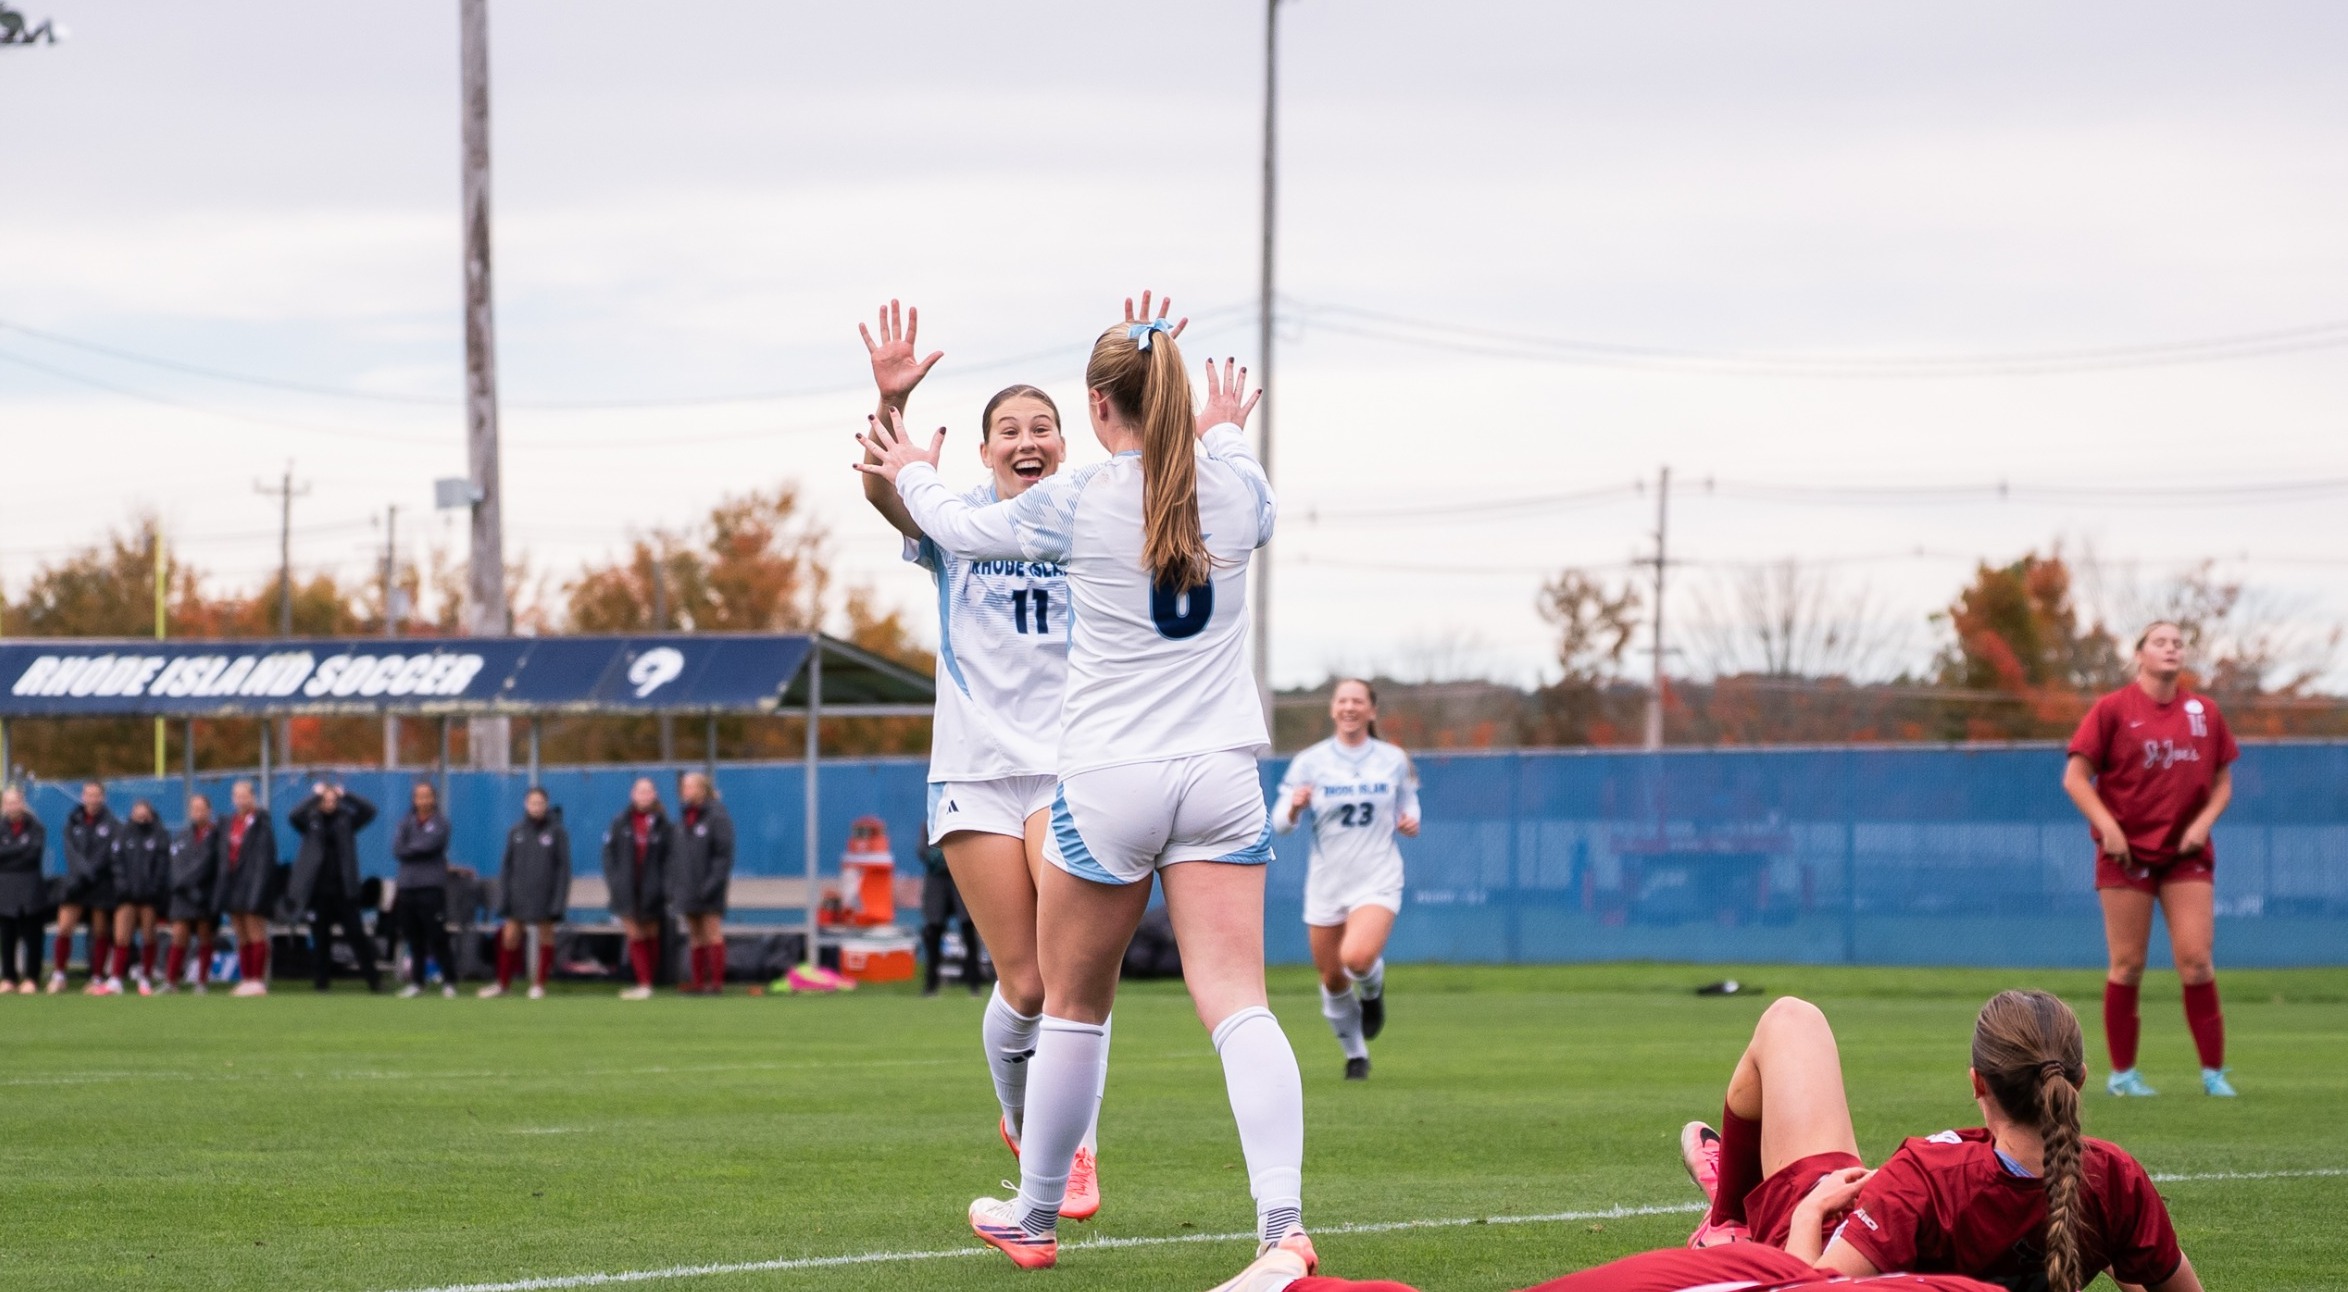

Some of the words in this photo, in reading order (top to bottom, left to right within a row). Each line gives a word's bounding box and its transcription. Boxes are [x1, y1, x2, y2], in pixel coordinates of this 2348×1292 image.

[971, 560, 1025, 577] RHODE
[1028, 561, 1068, 578] ISLA
[1011, 588, 1049, 634] 11
[12, 655, 166, 697] RHODE
[148, 653, 315, 697] ISLAND
[303, 654, 484, 697] SOCCER
[1340, 802, 1374, 828] 23
